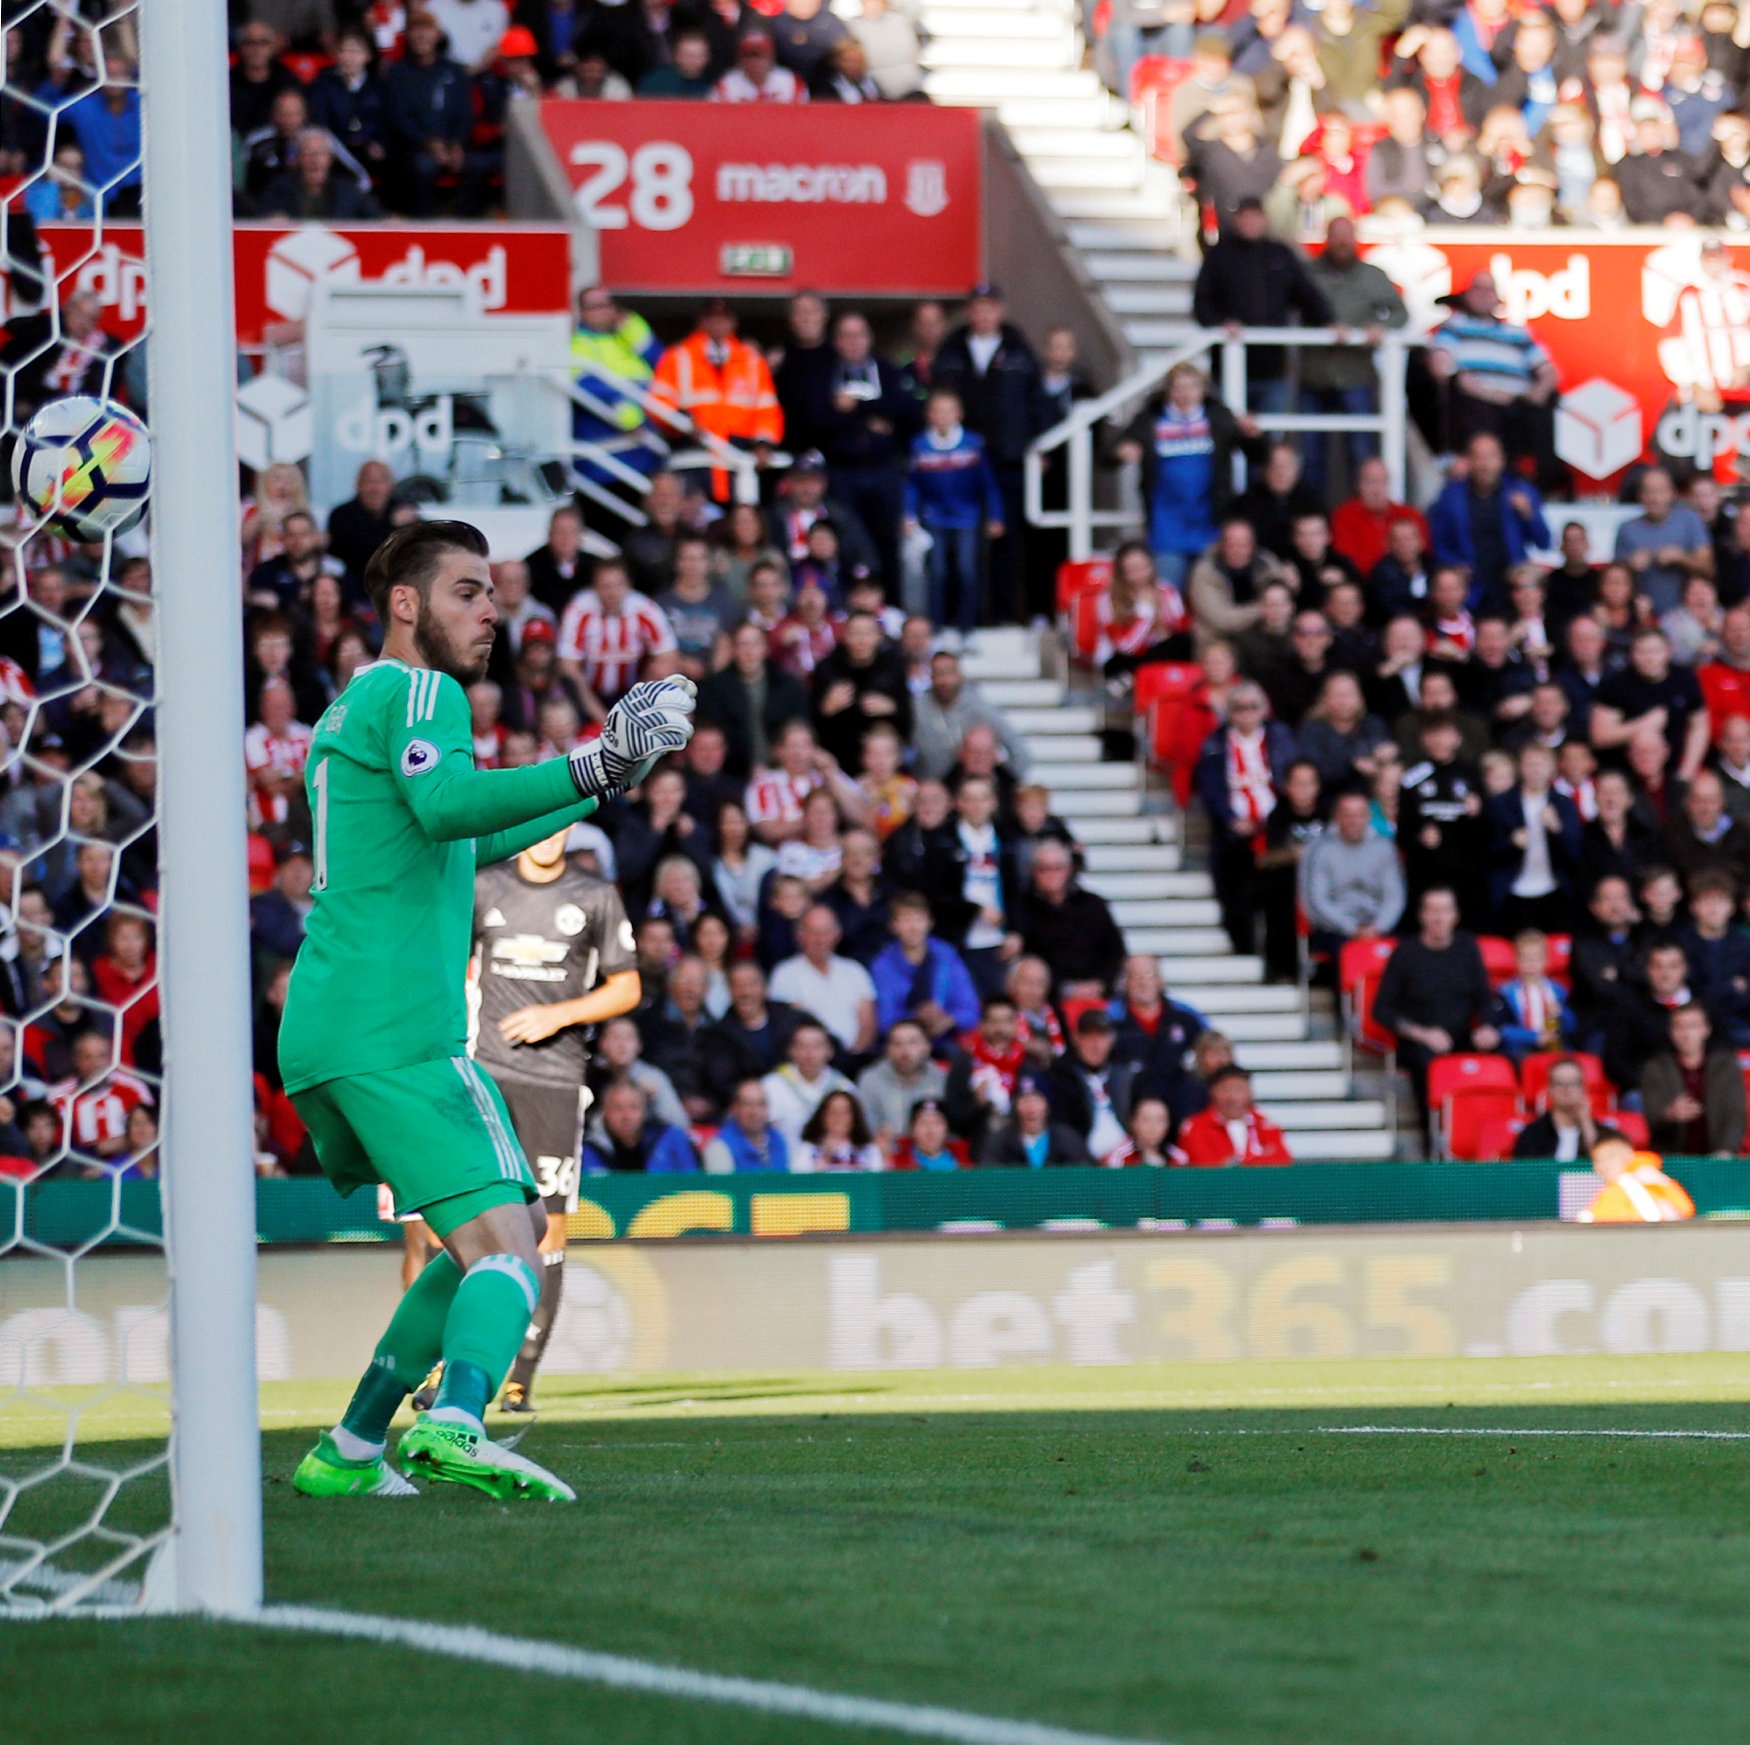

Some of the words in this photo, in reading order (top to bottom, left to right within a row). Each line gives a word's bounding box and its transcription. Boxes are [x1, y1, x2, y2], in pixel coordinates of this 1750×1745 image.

[571, 140, 695, 232] 28
[715, 162, 889, 204] macron
[76, 242, 147, 321] dp
[313, 756, 328, 891] 1
[535, 1155, 577, 1199] 36
